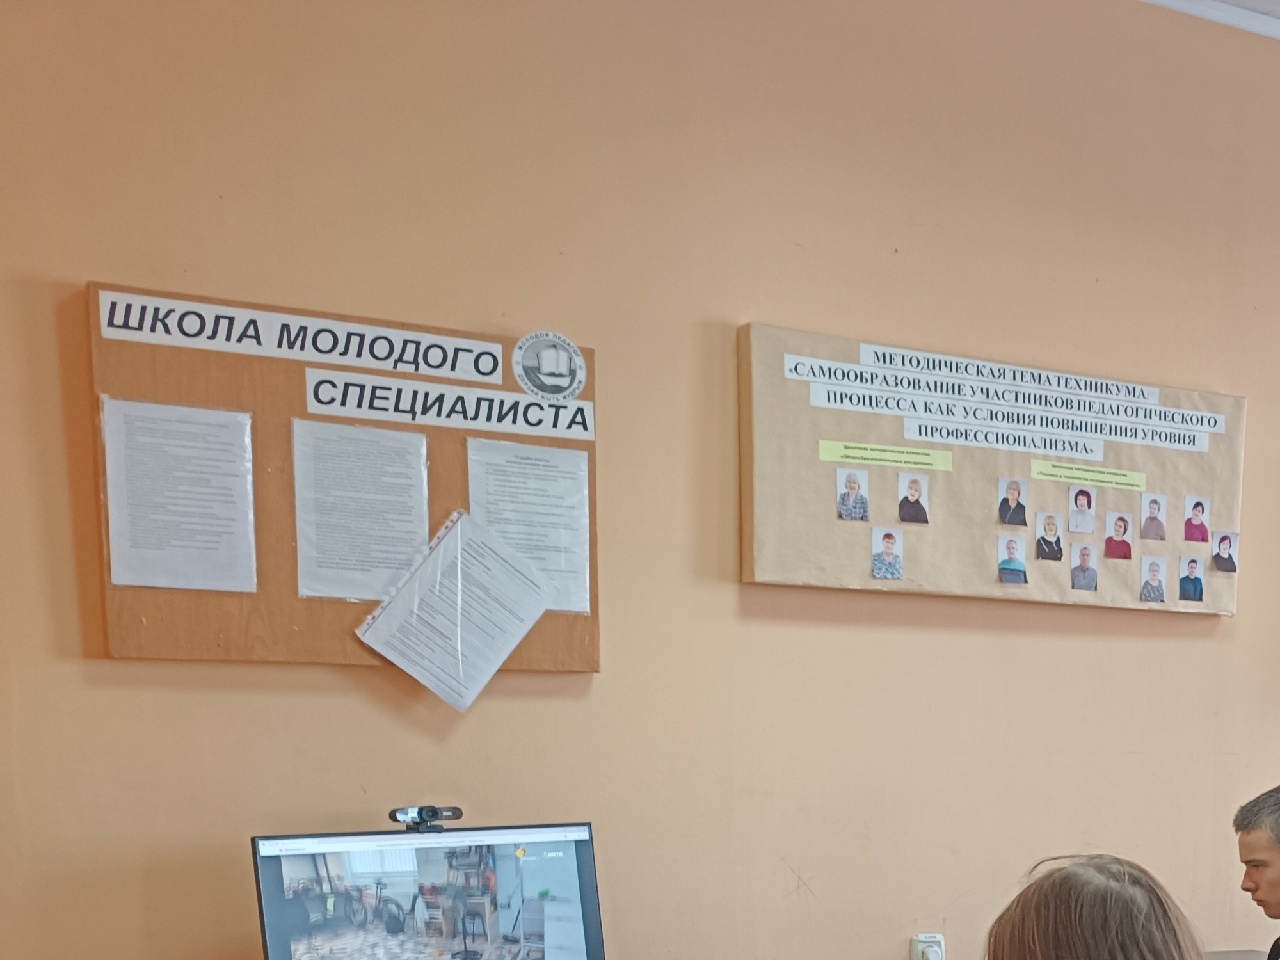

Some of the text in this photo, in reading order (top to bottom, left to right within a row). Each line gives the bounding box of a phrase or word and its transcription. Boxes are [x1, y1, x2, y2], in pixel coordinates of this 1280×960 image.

[107, 301, 499, 376] ШКОЛА МОЛОДОГО
[788, 361, 1218, 429] «САМООБРАЗОВАНИЕ УЧАСТНИКОВ ПЕДАГОГИЧЕСКОГО
[873, 350, 1151, 400] МЕТОДИЧЕСКАЯ ТЕМА ТЕХНИКУМА:
[313, 379, 589, 432] СПЕЦИАЛИСТА
[826, 389, 1197, 447] ПРОЦЕССА КАК УСЛОВИЯ ПОВЫШЕНИЯ УРОВНЯ
[918, 424, 1094, 455] ПРОФЕССИОНАЛИЗМА»
